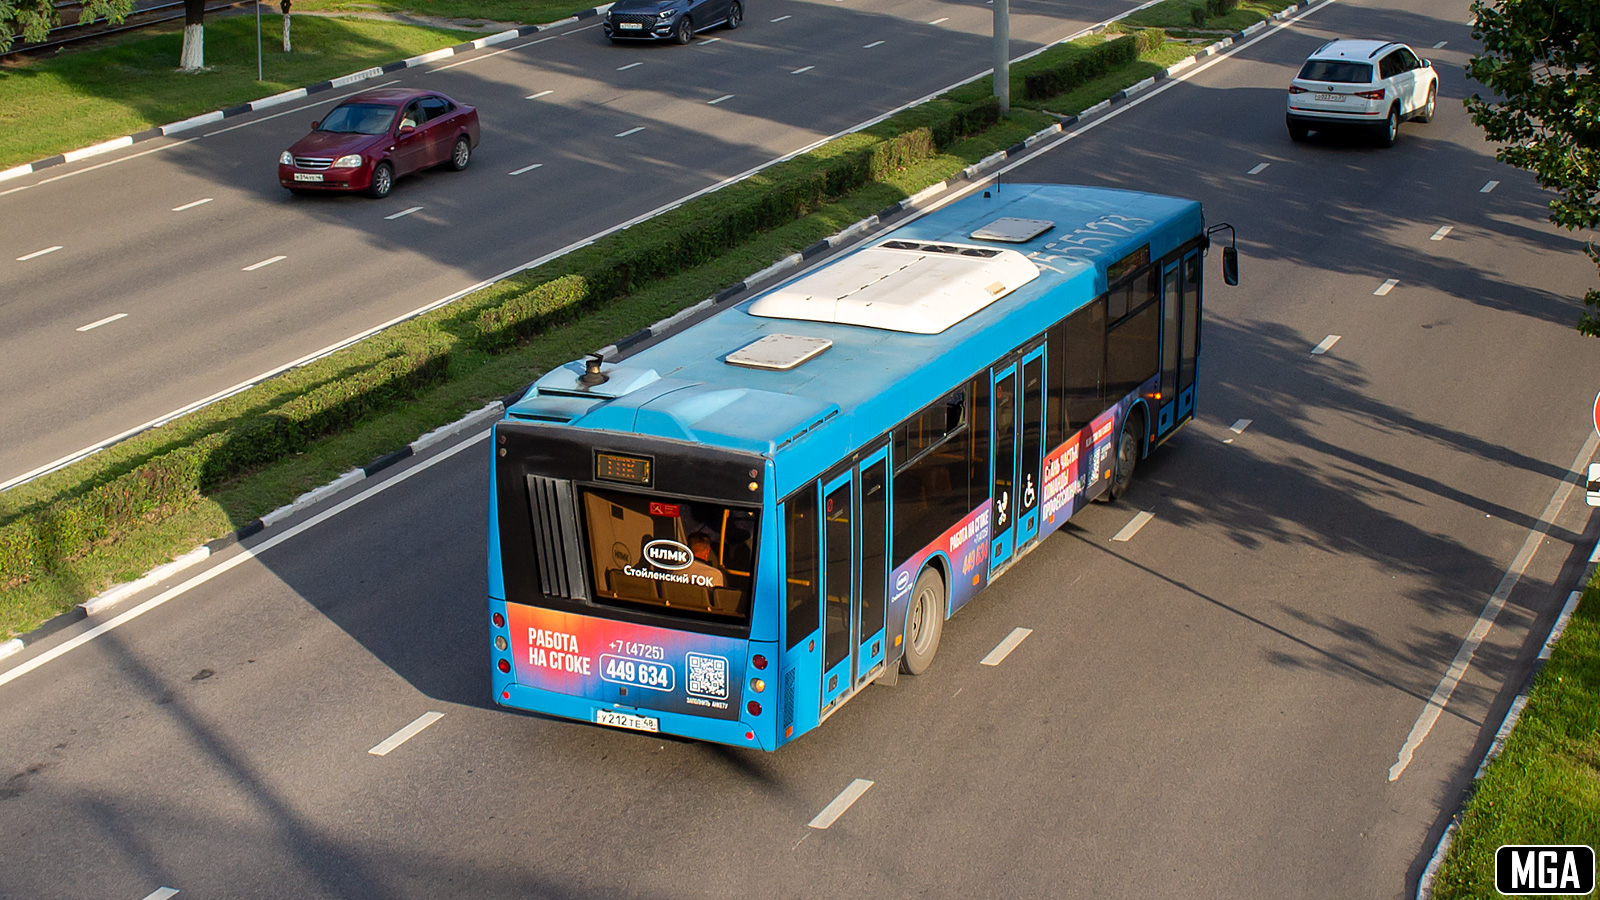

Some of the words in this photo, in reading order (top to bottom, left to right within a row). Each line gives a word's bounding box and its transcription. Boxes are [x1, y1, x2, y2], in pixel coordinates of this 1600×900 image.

[949, 525, 968, 552] РАБОТА
[967, 520, 975, 539] НА
[649, 547, 688, 562] НЛМК
[962, 549, 975, 576] 449
[976, 539, 988, 566] 634
[623, 565, 689, 584] Стойленский
[691, 574, 714, 587] ГОК
[528, 627, 579, 653] РАБОТА
[609, 640, 623, 653] +7
[626, 642, 664, 660] (4725)
[529, 647, 547, 667] НА
[549, 651, 591, 675] СГОКЕ
[606, 659, 635, 681] 449
[638, 664, 668, 687] 634
